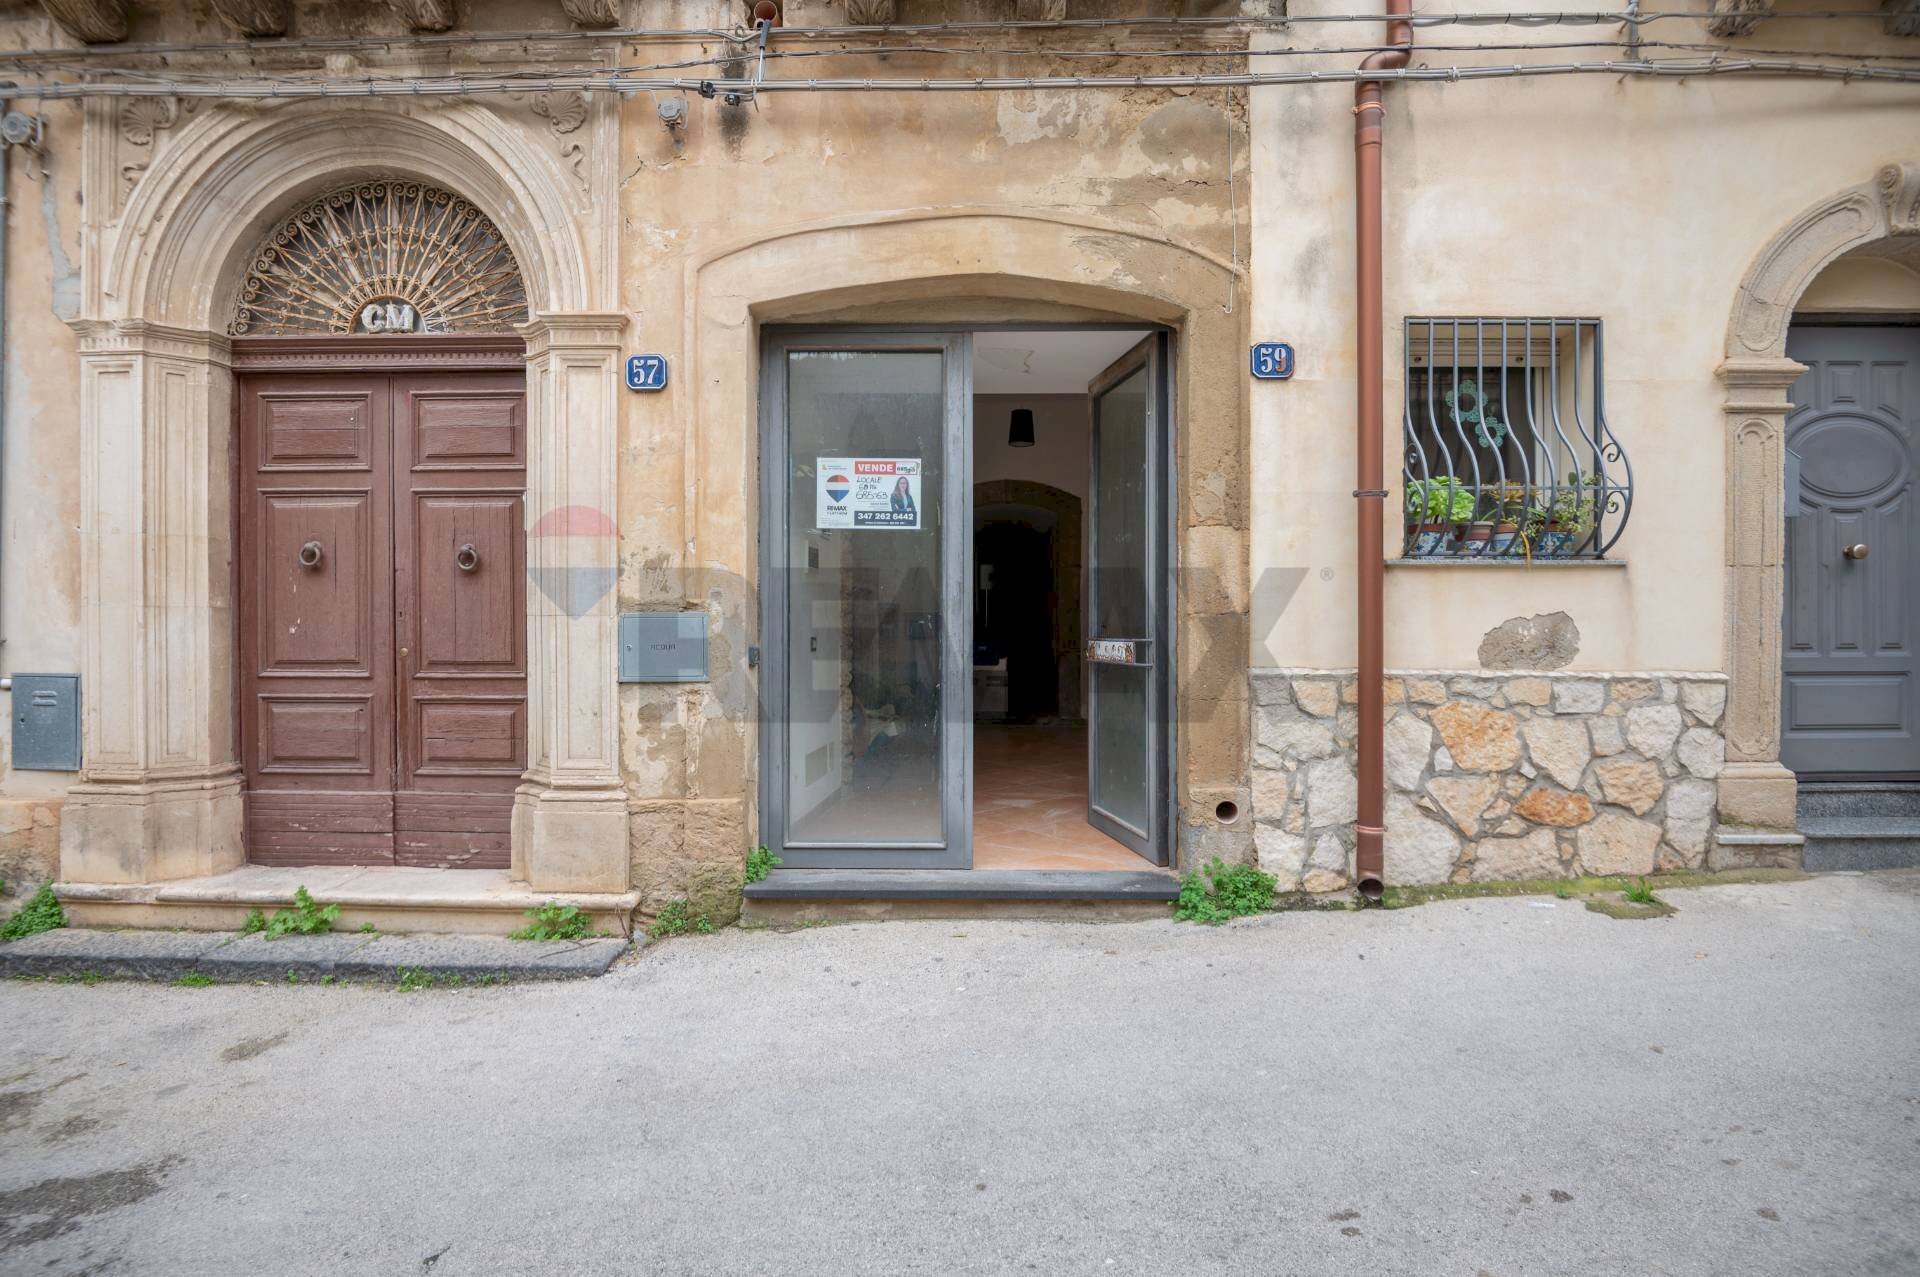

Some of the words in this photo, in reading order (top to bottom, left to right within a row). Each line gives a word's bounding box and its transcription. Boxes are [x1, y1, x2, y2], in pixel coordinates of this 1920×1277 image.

[1260, 347, 1287, 373] 59
[632, 359, 659, 385] 57
[857, 464, 894, 472] VENDE
[857, 512, 873, 520] 347
[892, 512, 914, 521] 6442
